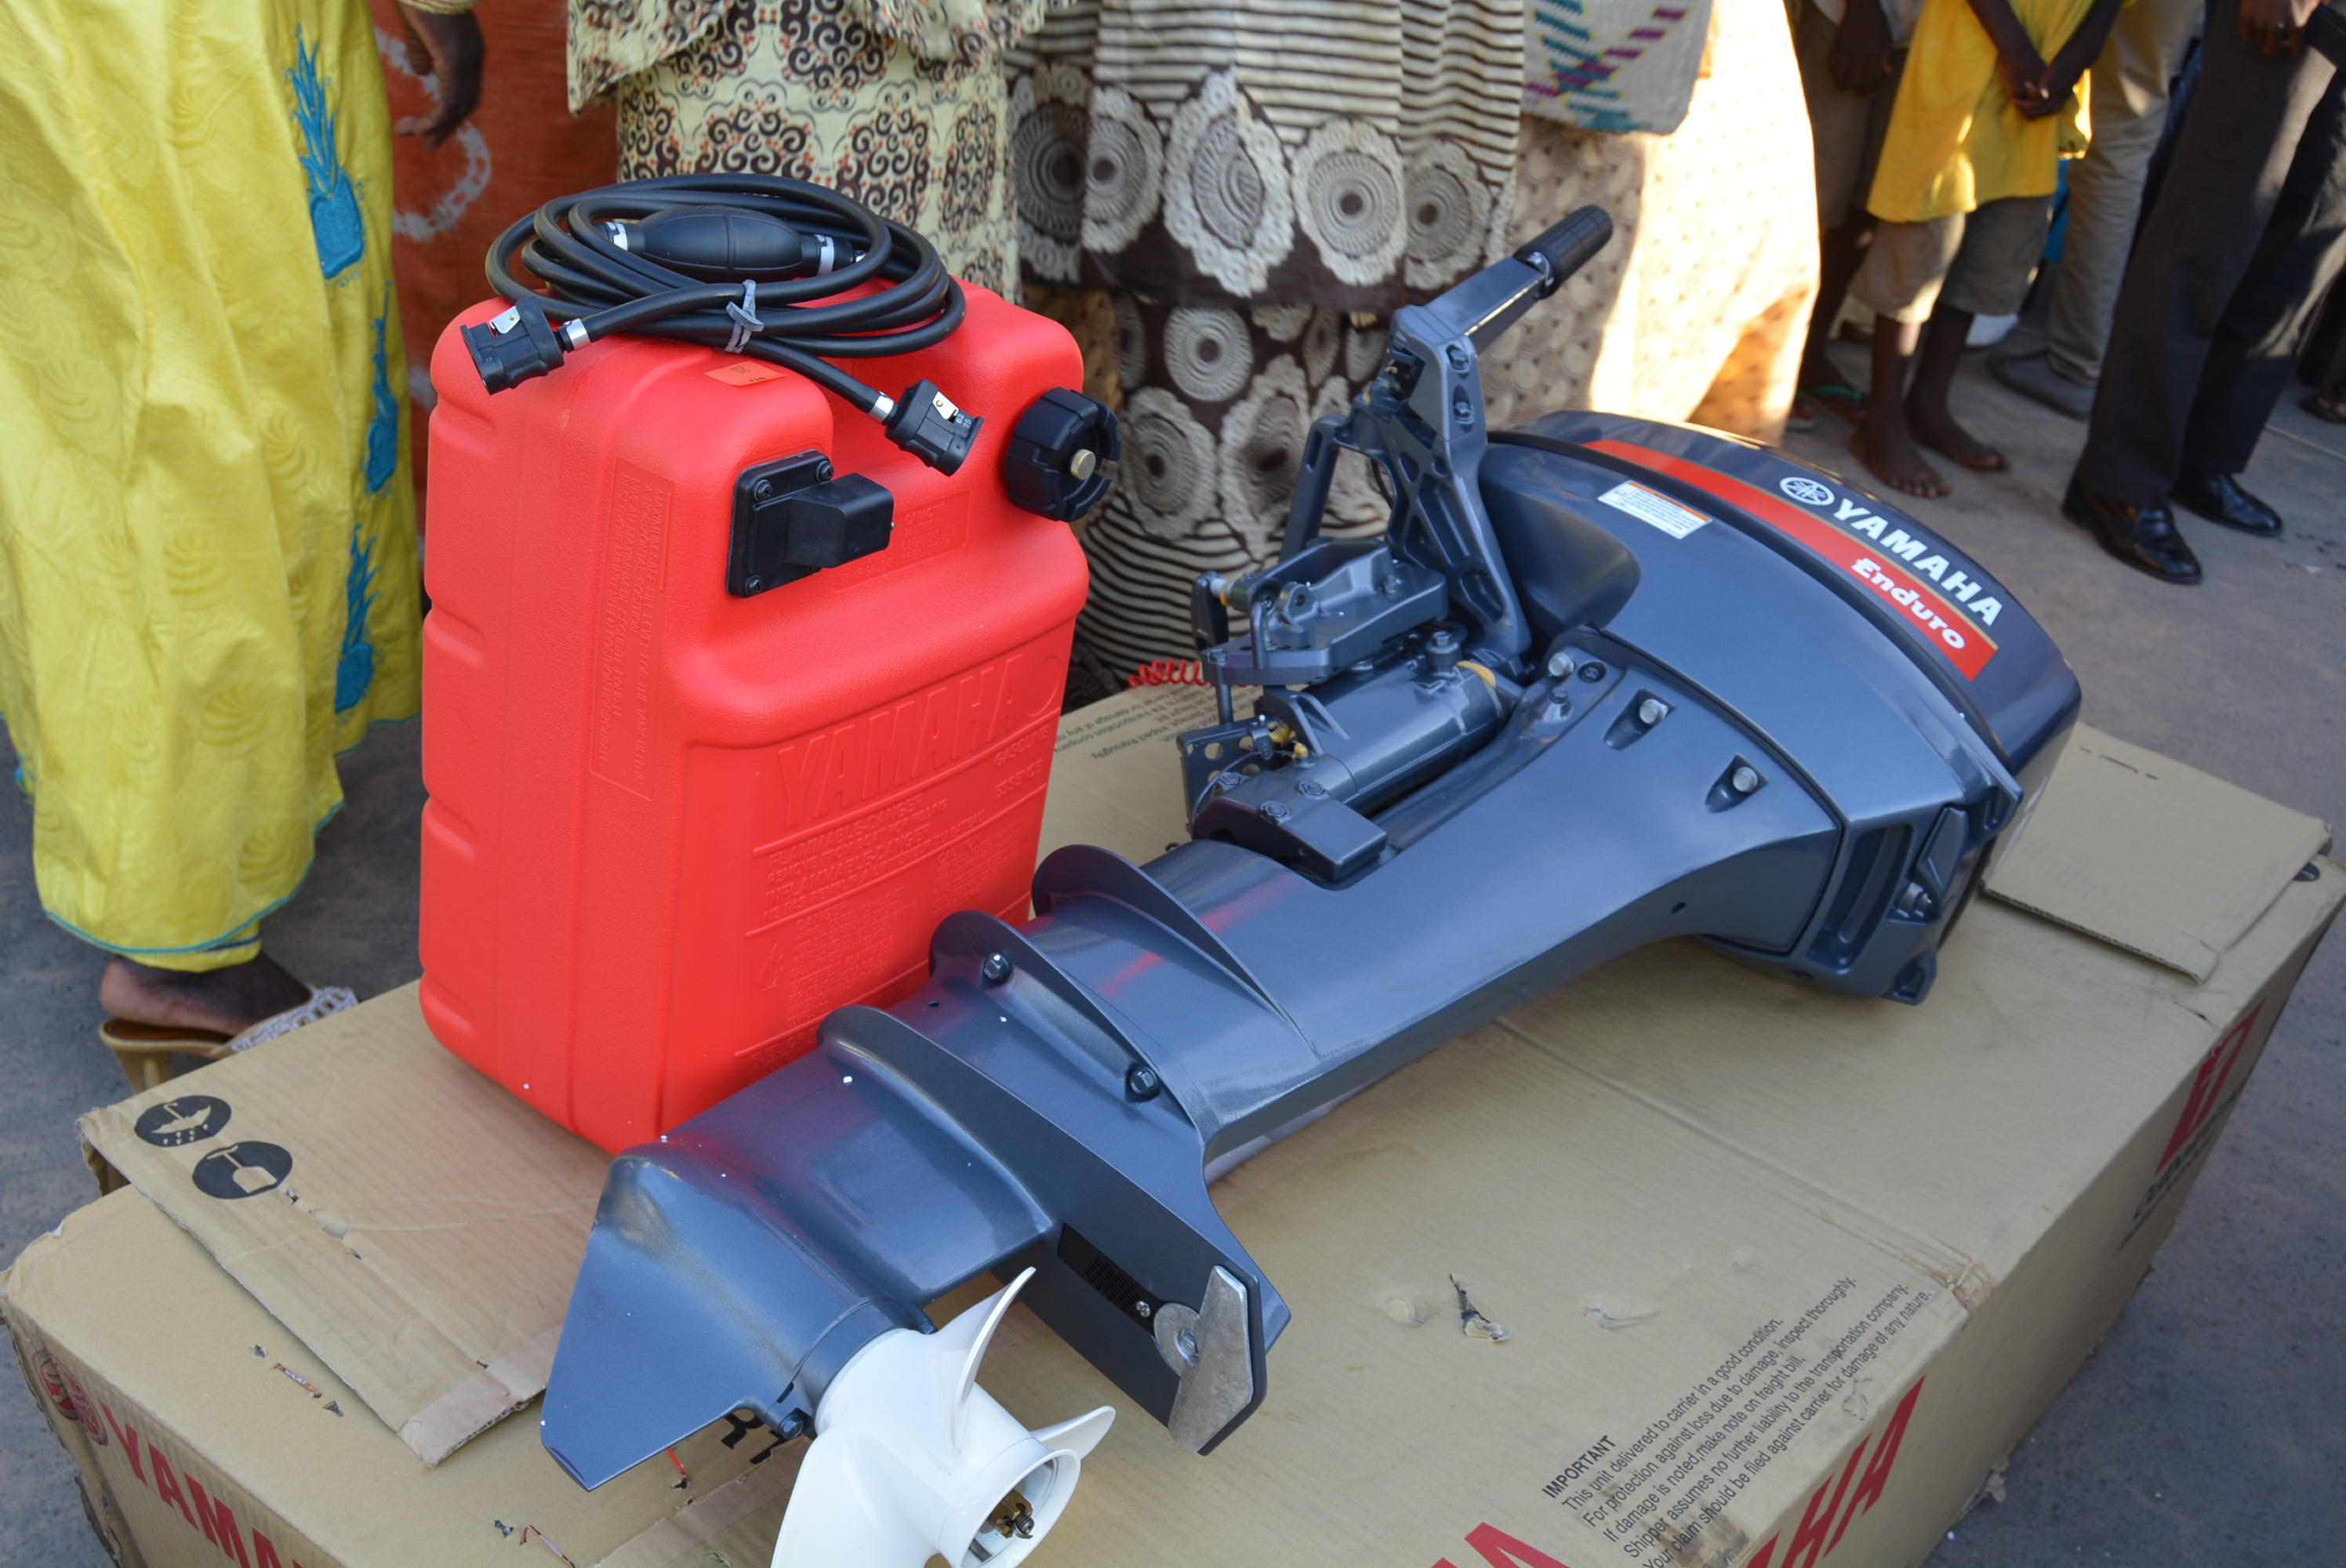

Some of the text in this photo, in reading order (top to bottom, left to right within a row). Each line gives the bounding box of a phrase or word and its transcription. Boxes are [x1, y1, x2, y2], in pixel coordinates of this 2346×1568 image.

[646, 552, 658, 586] SAFE
[650, 488, 663, 550] MAXIMUM
[1832, 498, 2003, 626] YAMAHA
[640, 613, 652, 648] LEVEL
[1851, 557, 1966, 650] Enduro
[779, 652, 1023, 829] YAMAHA
[1542, 1435, 1614, 1497] IMPORTANT
[1561, 1489, 1592, 1510] This
[1589, 1470, 1614, 1490] unit
[1610, 1427, 1658, 1472] delivered
[1652, 1420, 1669, 1431] to
[1666, 1392, 1699, 1421] carrier
[1693, 1384, 1711, 1395] in
[1715, 1353, 1741, 1380] good
[1738, 1319, 1783, 1356] condition.
[1582, 1277, 1855, 1526] For protection against loss due to damage, inspect thoroughly.
[1603, 1528, 1618, 1541] If
[1615, 1494, 1659, 1533] damage
[1653, 1484, 1670, 1495] is
[1722, 1411, 1747, 1432] note
[1744, 1399, 1760, 1411] on
[1753, 1370, 1789, 1399] freight
[1781, 1355, 1805, 1372] bill.
[1624, 1284, 1908, 1557] Shipper assumes no further liability to the transportation company.
[1642, 1292, 1931, 1568] Your claim should be filed against carrier for damage of any nature.
